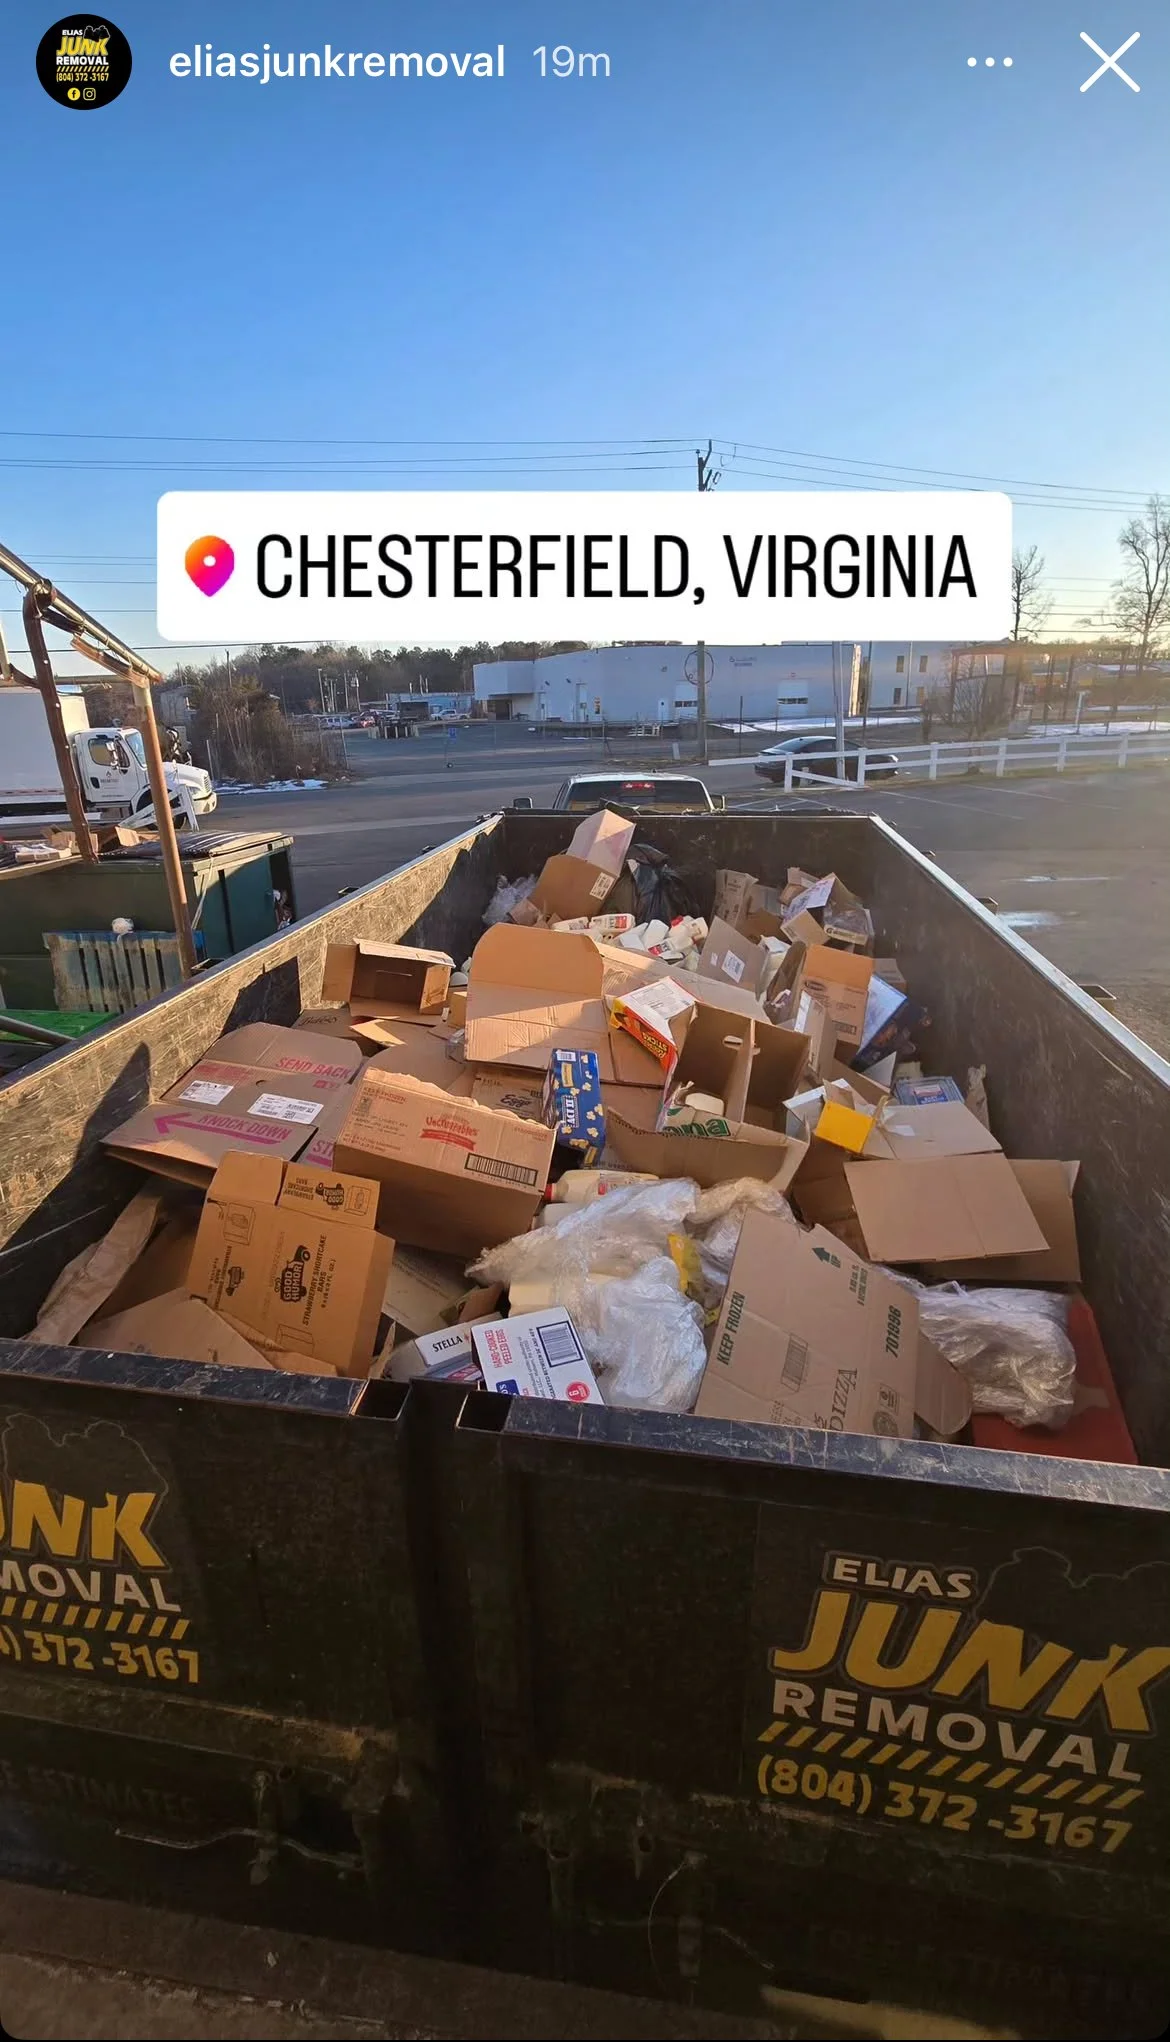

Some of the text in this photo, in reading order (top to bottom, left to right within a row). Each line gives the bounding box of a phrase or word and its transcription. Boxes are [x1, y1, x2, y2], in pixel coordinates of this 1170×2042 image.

[275, 1057, 352, 1080] SEND BACK
[198, 1113, 293, 1141] KNOCK DOWN
[283, 1270, 293, 1300] GOOD
[291, 1264, 304, 1300] HUMOR
[302, 1274, 319, 1327] STRAWBERRY
[432, 1335, 463, 1352] STELLA
[716, 1291, 746, 1366] KEEP FROZEN
[0, 1479, 168, 1568] NK
[832, 1557, 973, 1599] ELIAS
[24, 1629, 94, 1671] 372
[102, 1641, 200, 1684] -3167
[773, 1590, 1170, 1732] JUNK
[772, 1678, 1143, 1783] REMOVAL
[757, 1754, 1134, 1854] (804) 372 -3167
